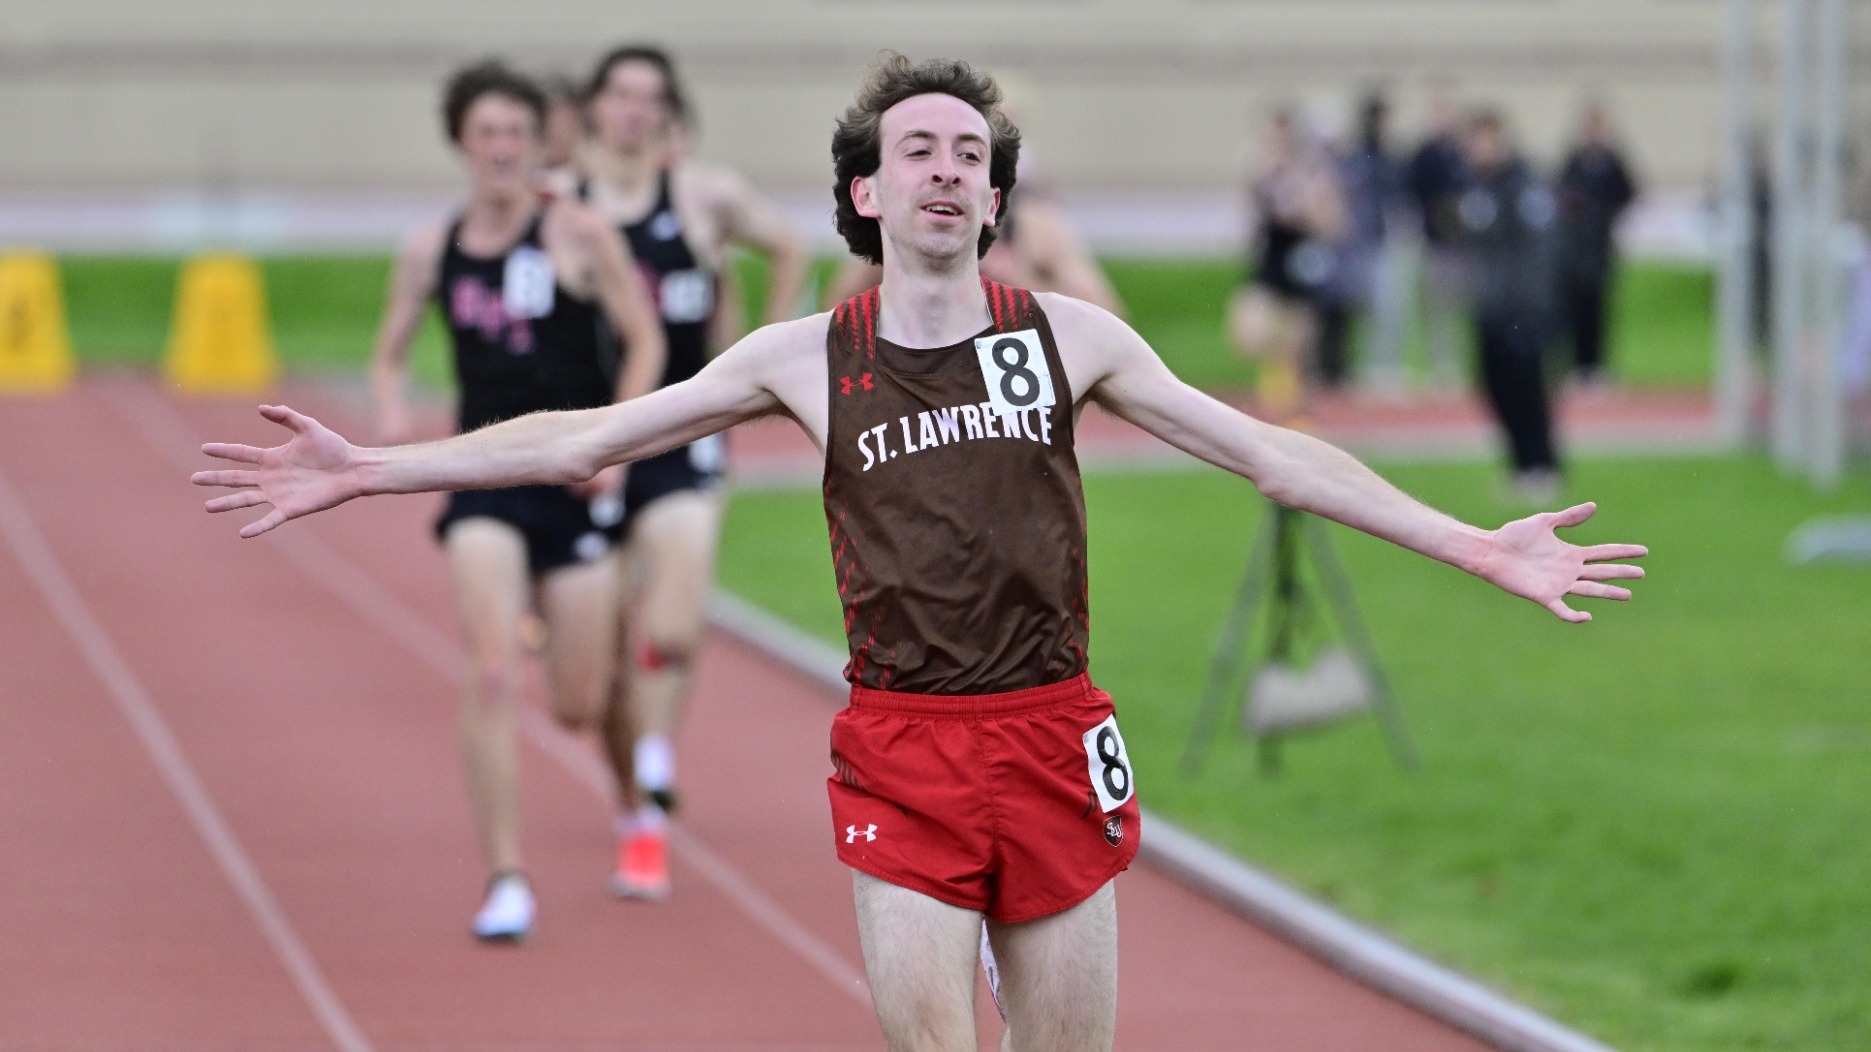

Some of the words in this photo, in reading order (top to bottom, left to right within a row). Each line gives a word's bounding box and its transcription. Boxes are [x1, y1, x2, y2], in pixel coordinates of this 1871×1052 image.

[992, 337, 1040, 406] 8
[857, 422, 897, 472] ST.
[900, 401, 1052, 455] LAWRENCE
[1096, 725, 1129, 801] 8
